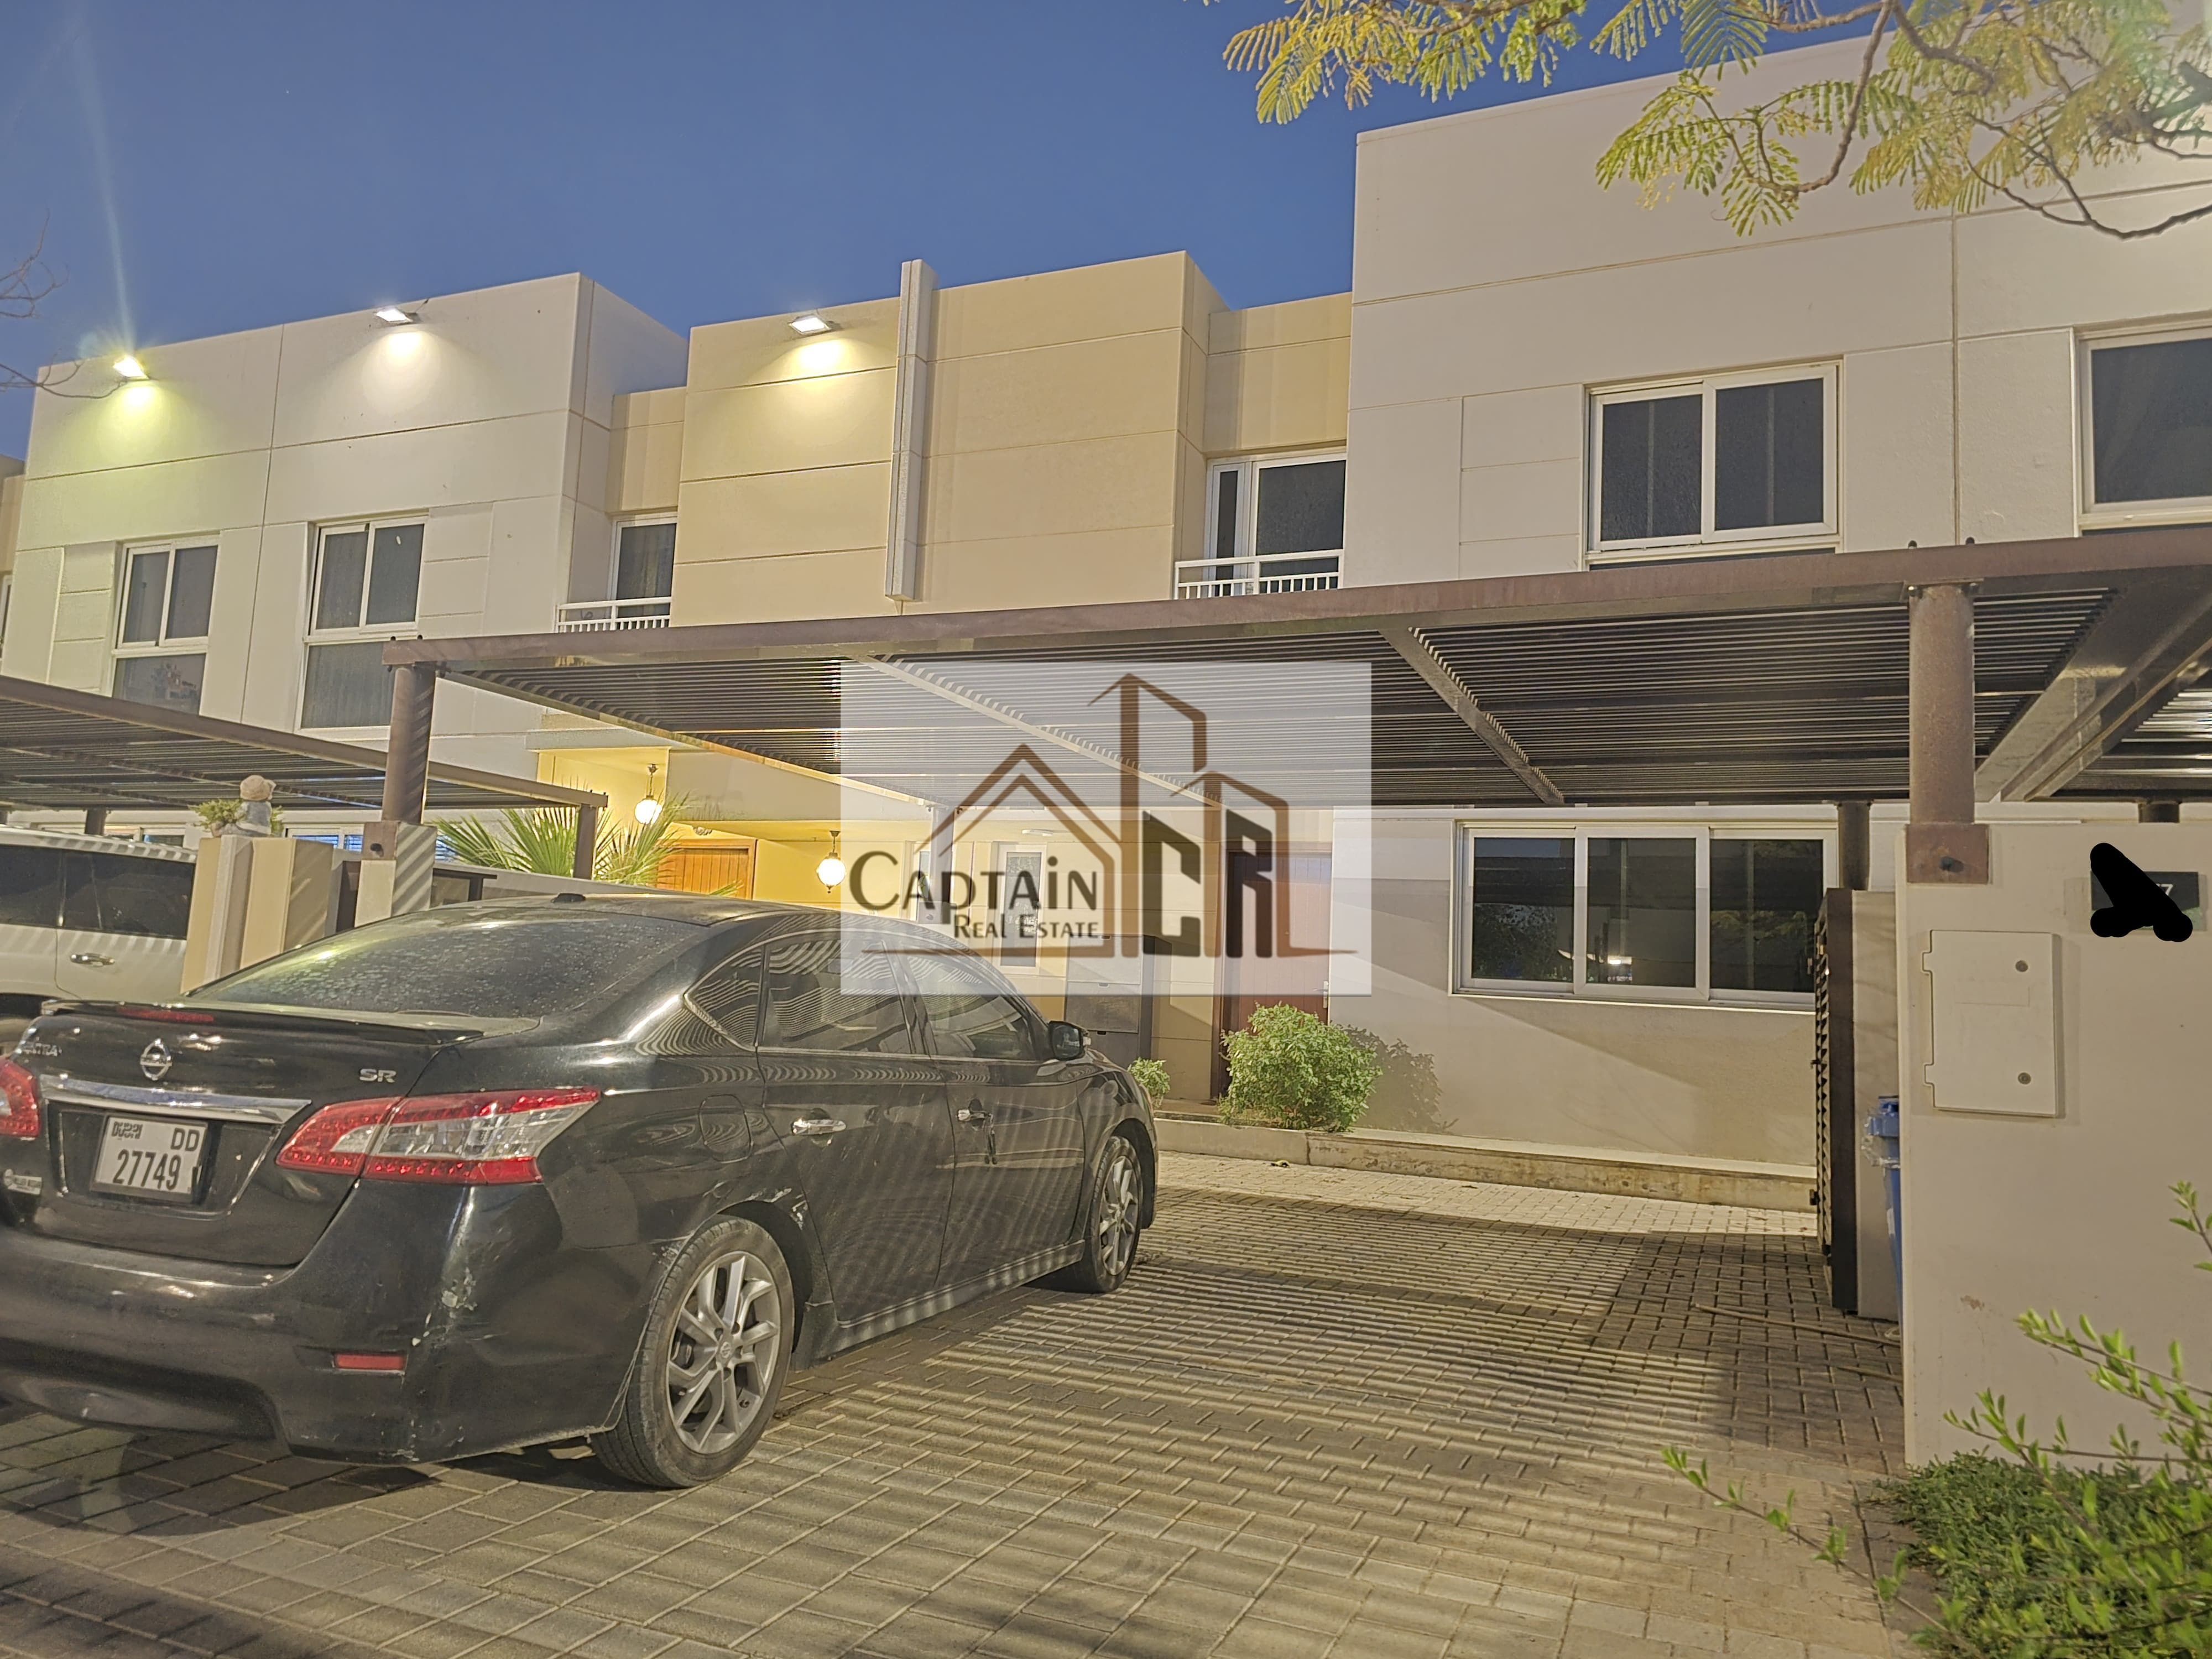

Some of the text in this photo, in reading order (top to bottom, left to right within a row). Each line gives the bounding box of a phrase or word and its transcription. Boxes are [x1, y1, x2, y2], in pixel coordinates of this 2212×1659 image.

[359, 1068, 397, 1083] SR
[170, 1128, 200, 1151] DD
[112, 1149, 181, 1190] 27749
